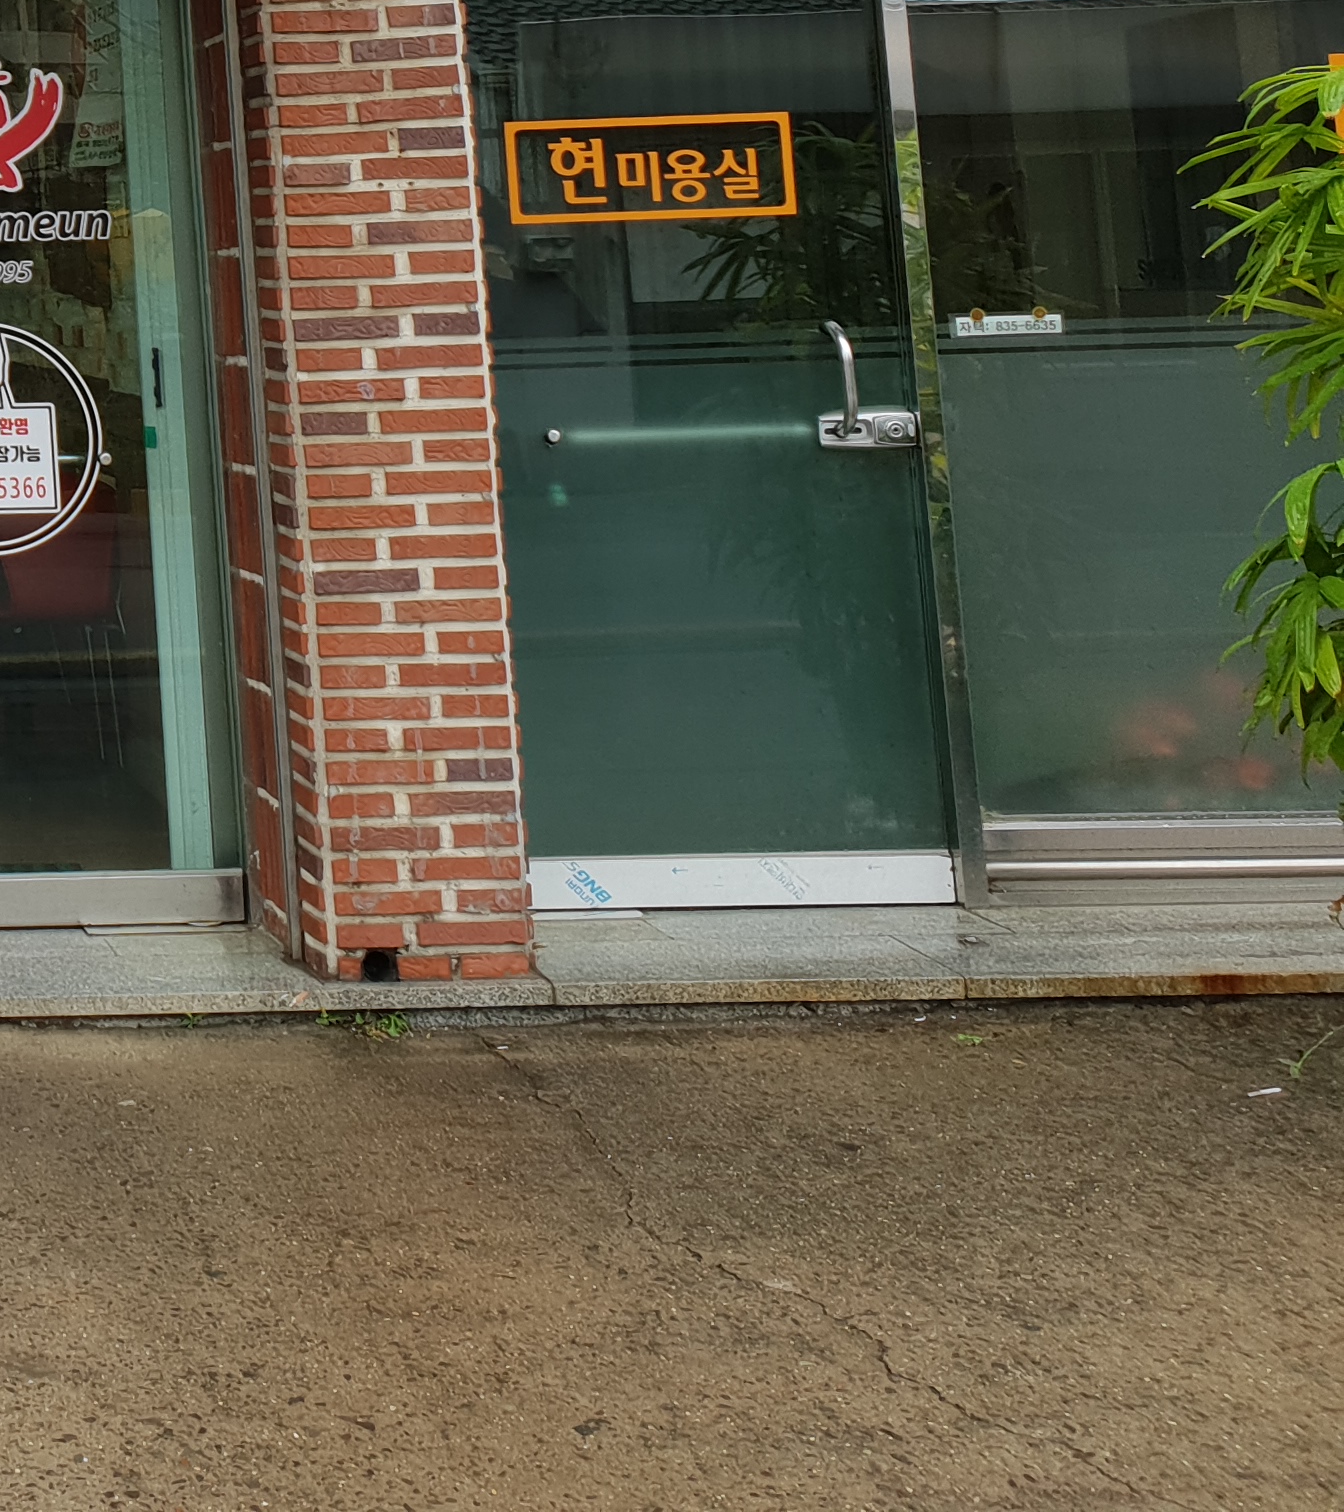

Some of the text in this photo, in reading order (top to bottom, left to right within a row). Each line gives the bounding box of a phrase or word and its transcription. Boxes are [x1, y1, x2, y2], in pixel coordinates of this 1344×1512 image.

[547, 137, 760, 205] 현 미용실
[995, 319, 1057, 332] 835-6635
